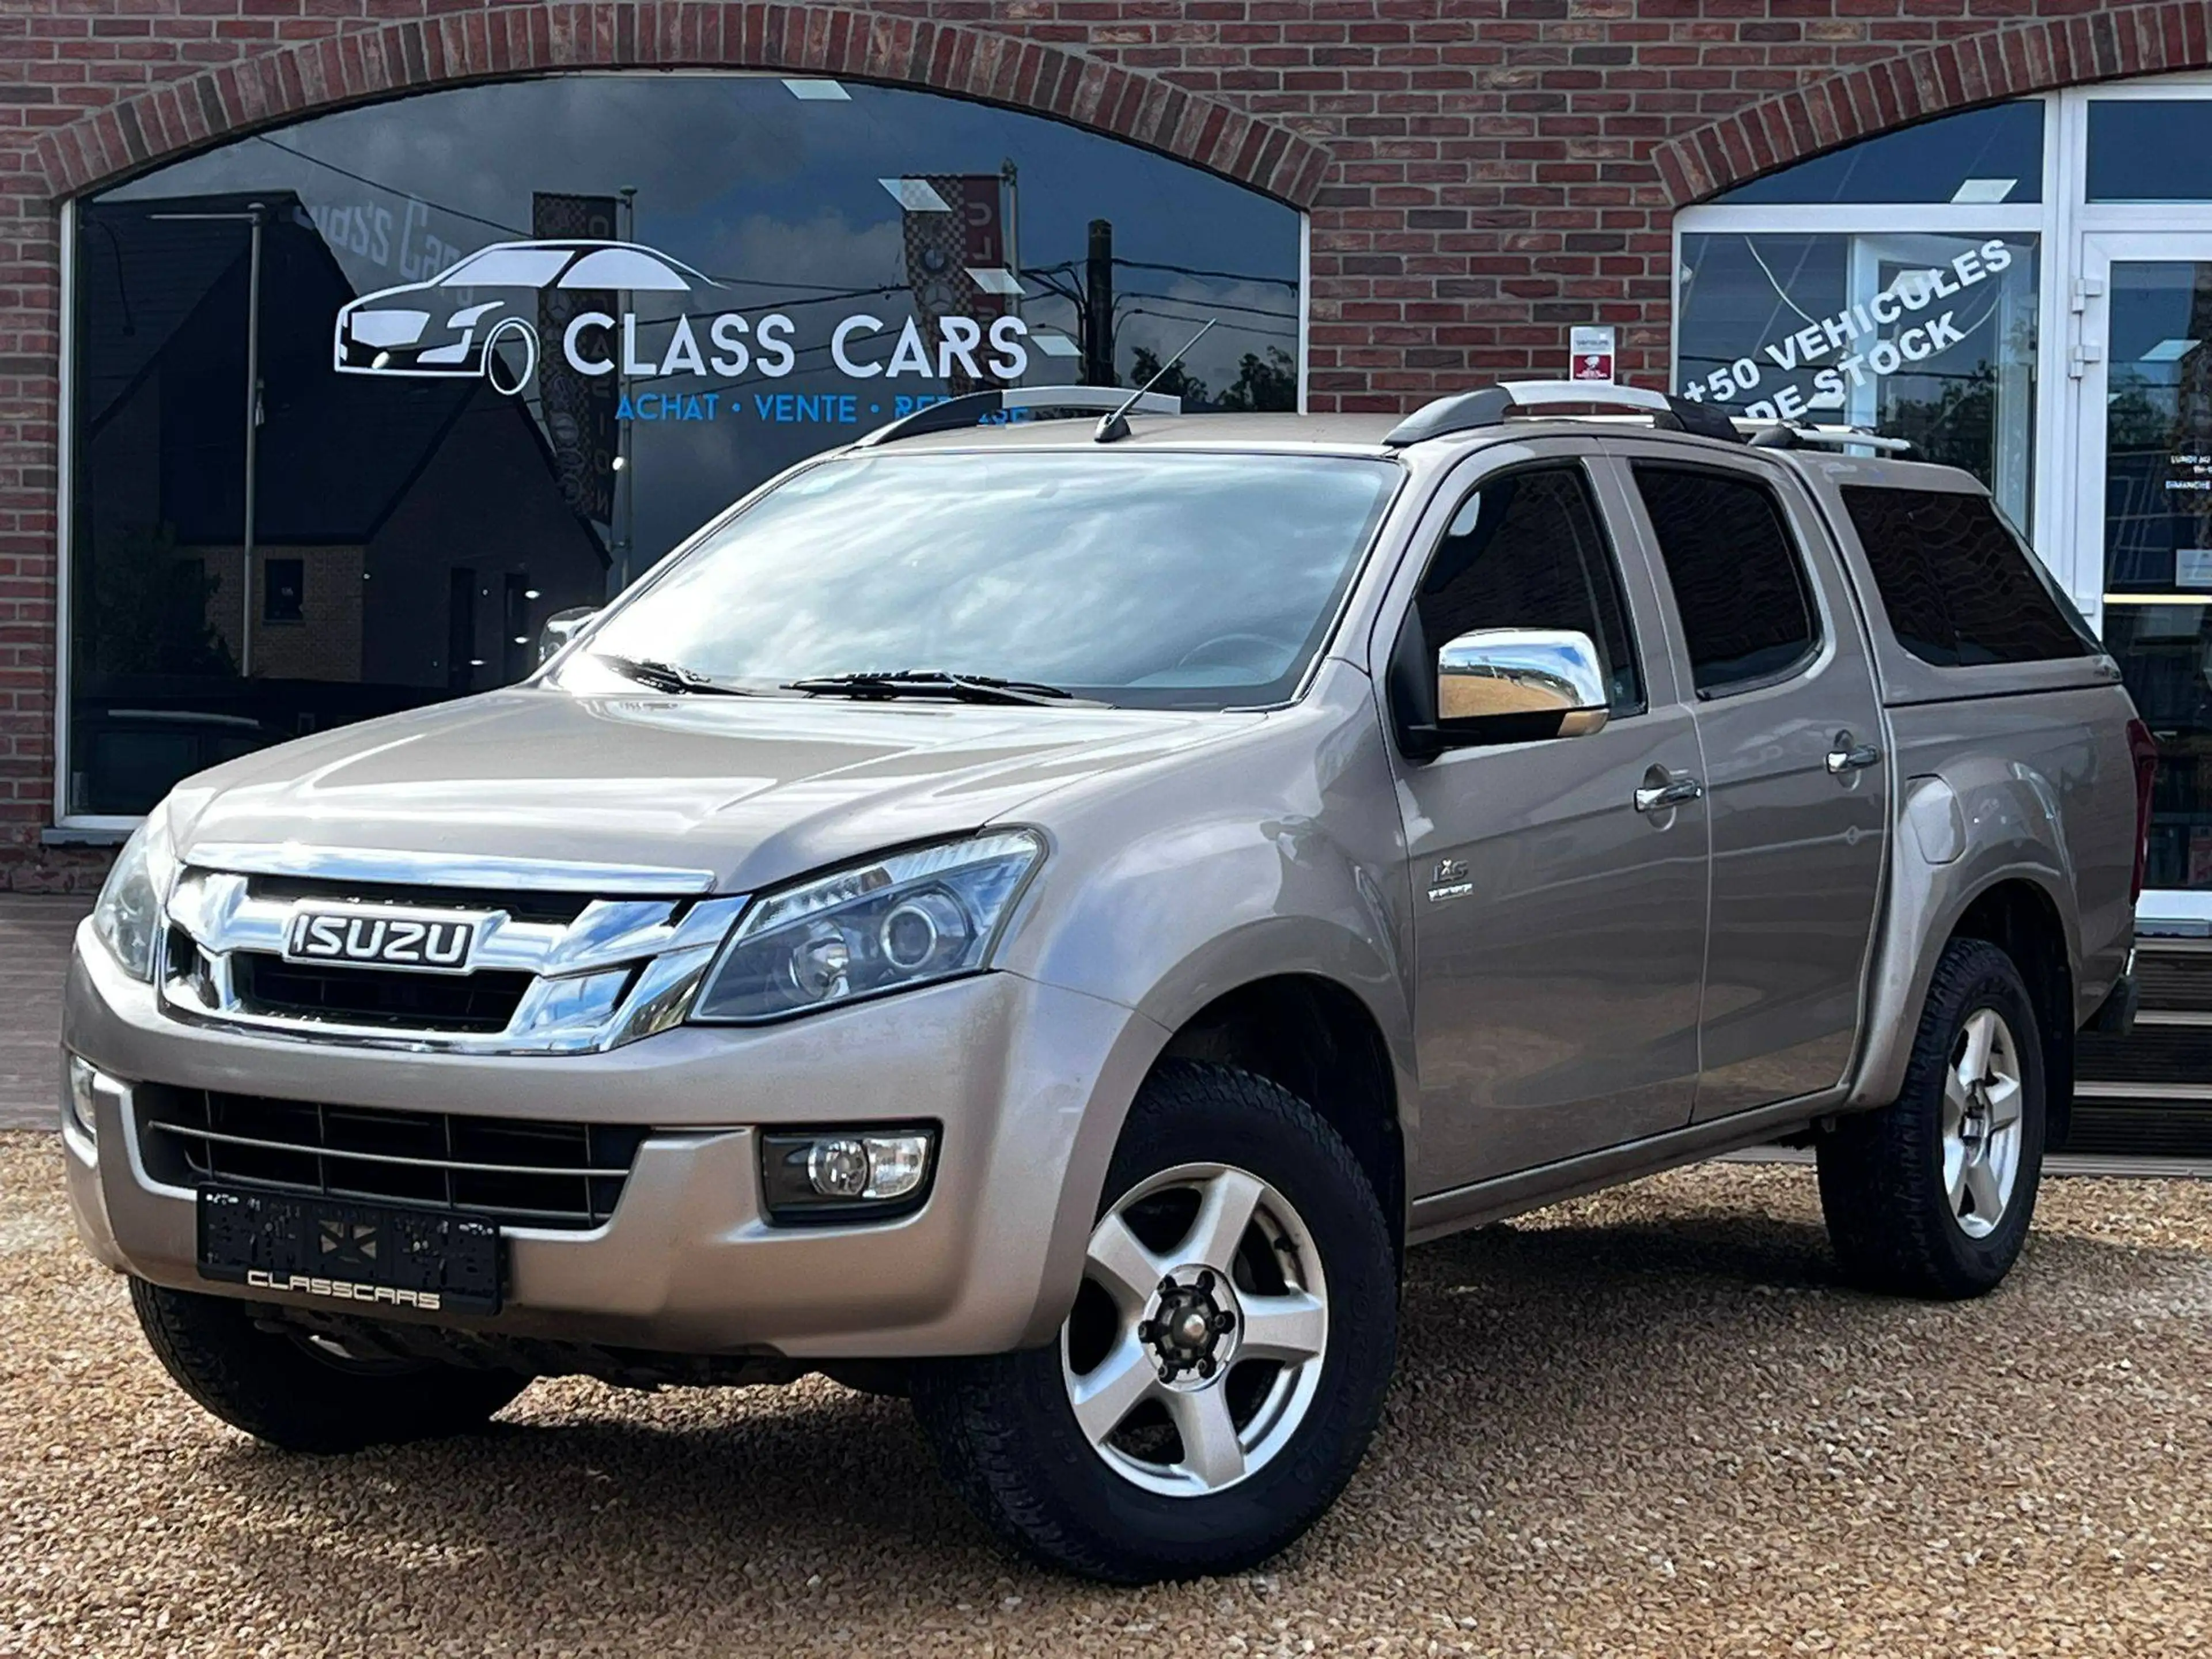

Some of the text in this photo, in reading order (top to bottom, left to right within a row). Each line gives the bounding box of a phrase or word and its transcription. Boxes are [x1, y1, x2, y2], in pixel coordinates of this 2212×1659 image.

[563, 312, 1028, 379] CLASS CARS
[1683, 238, 2012, 404] +50 VEHICULES
[1813, 310, 1965, 401] STOCK
[615, 393, 719, 421] ACHAT
[753, 393, 858, 422] VENTE
[292, 914, 467, 964] ISUZU
[247, 1270, 441, 1310] CLASSCARS
